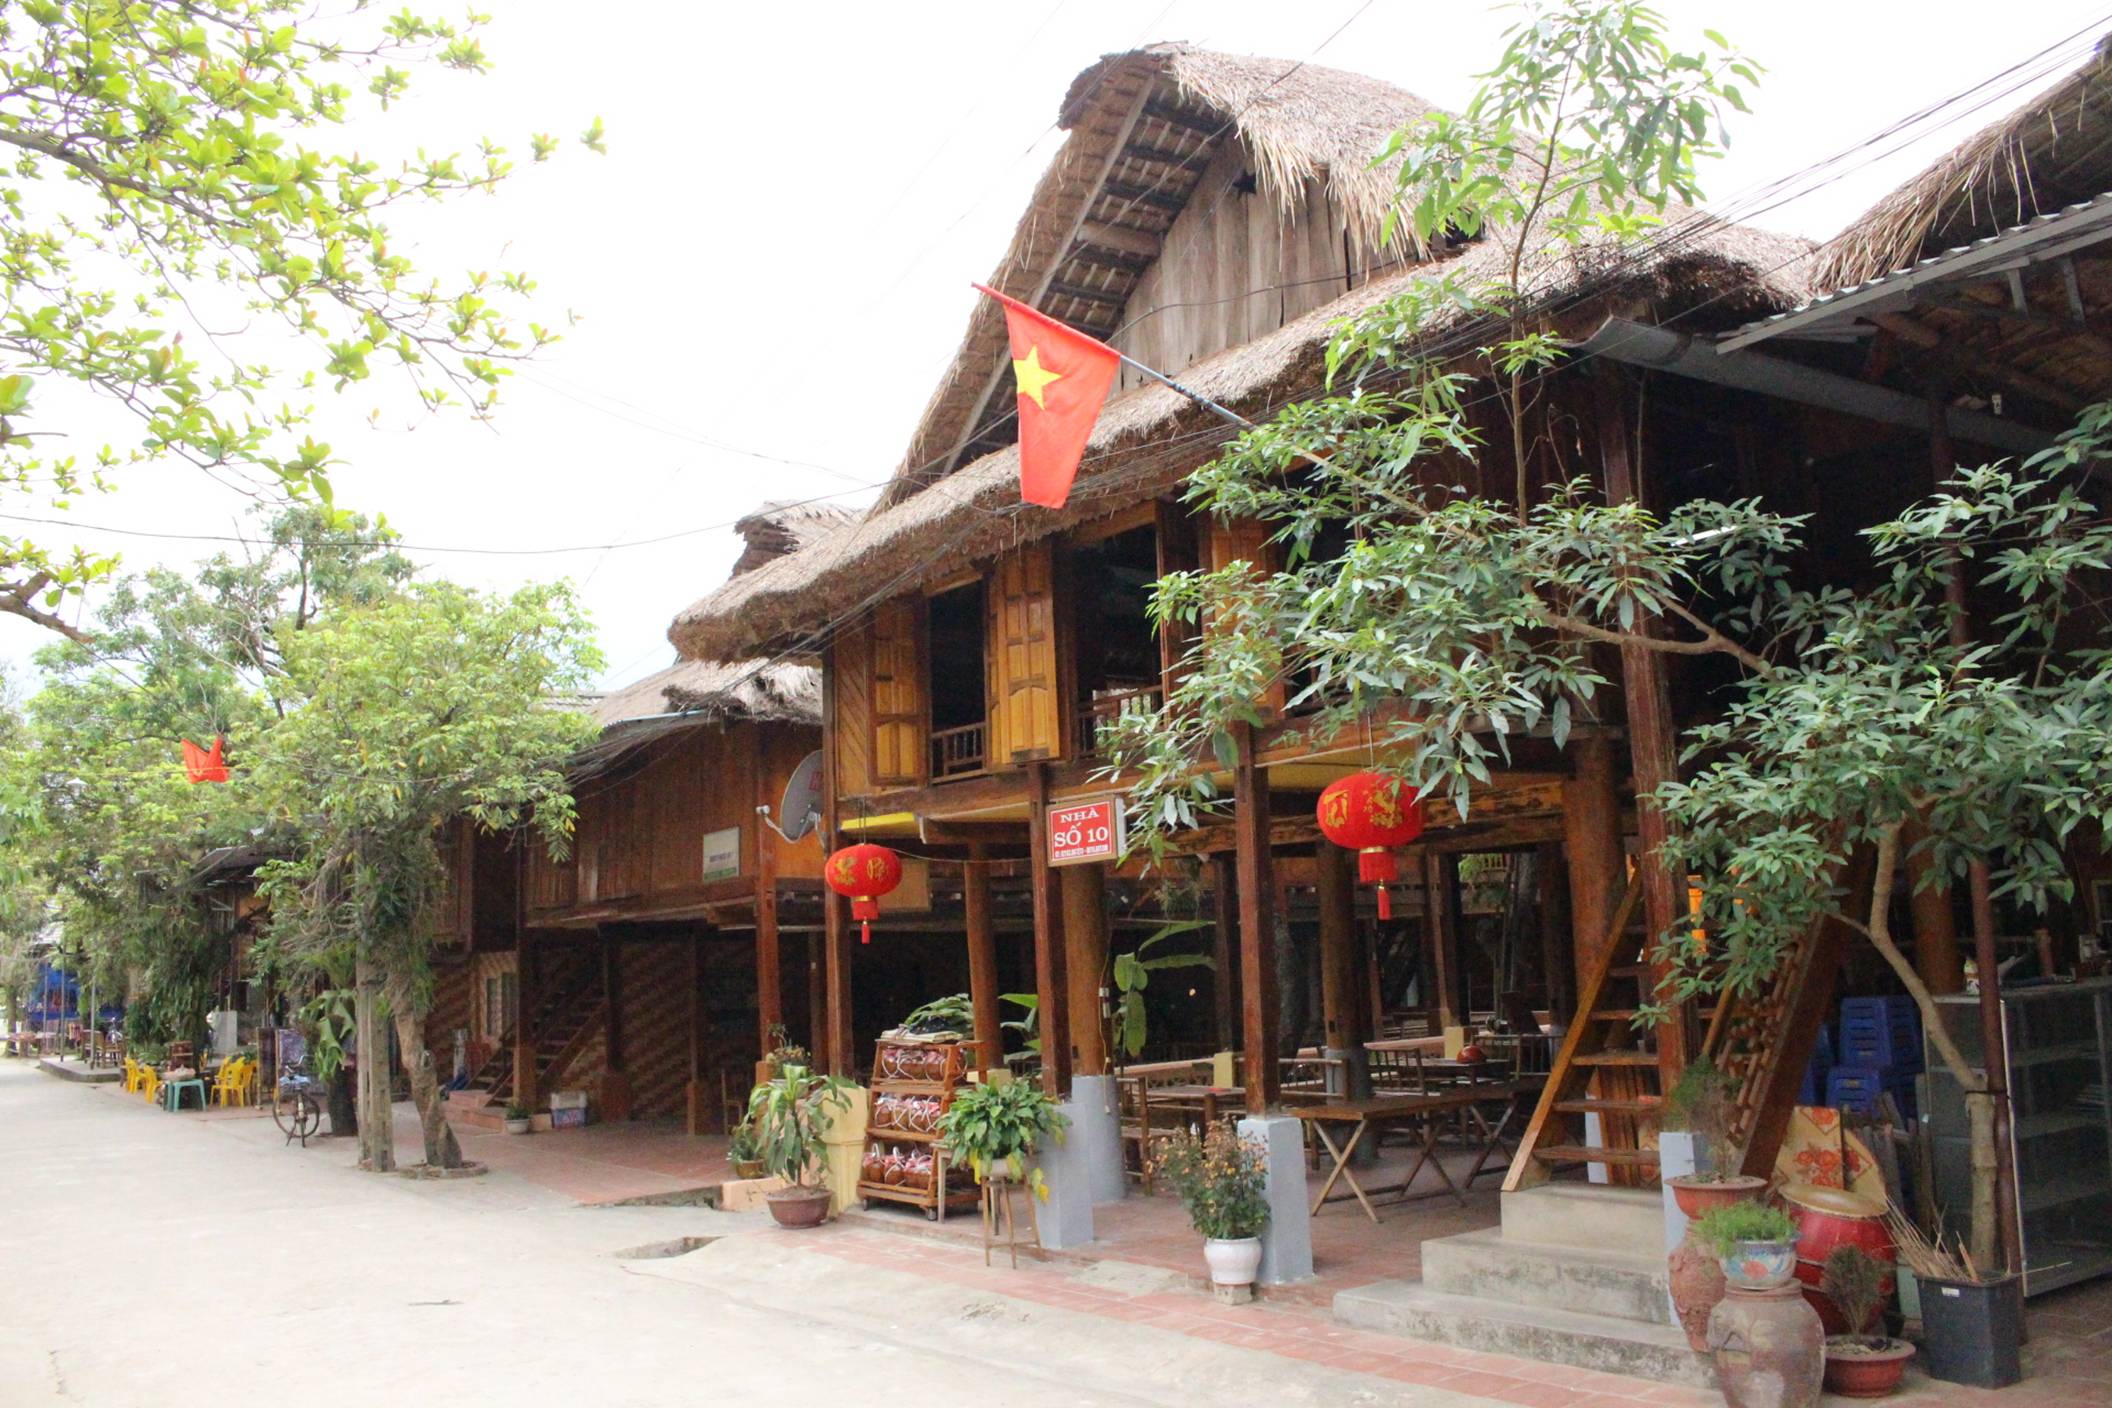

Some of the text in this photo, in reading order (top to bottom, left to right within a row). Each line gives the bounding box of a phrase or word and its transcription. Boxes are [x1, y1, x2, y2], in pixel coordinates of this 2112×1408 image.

[1060, 807, 1099, 823] NHÀ
[1054, 821, 1108, 847] SỐ 10
